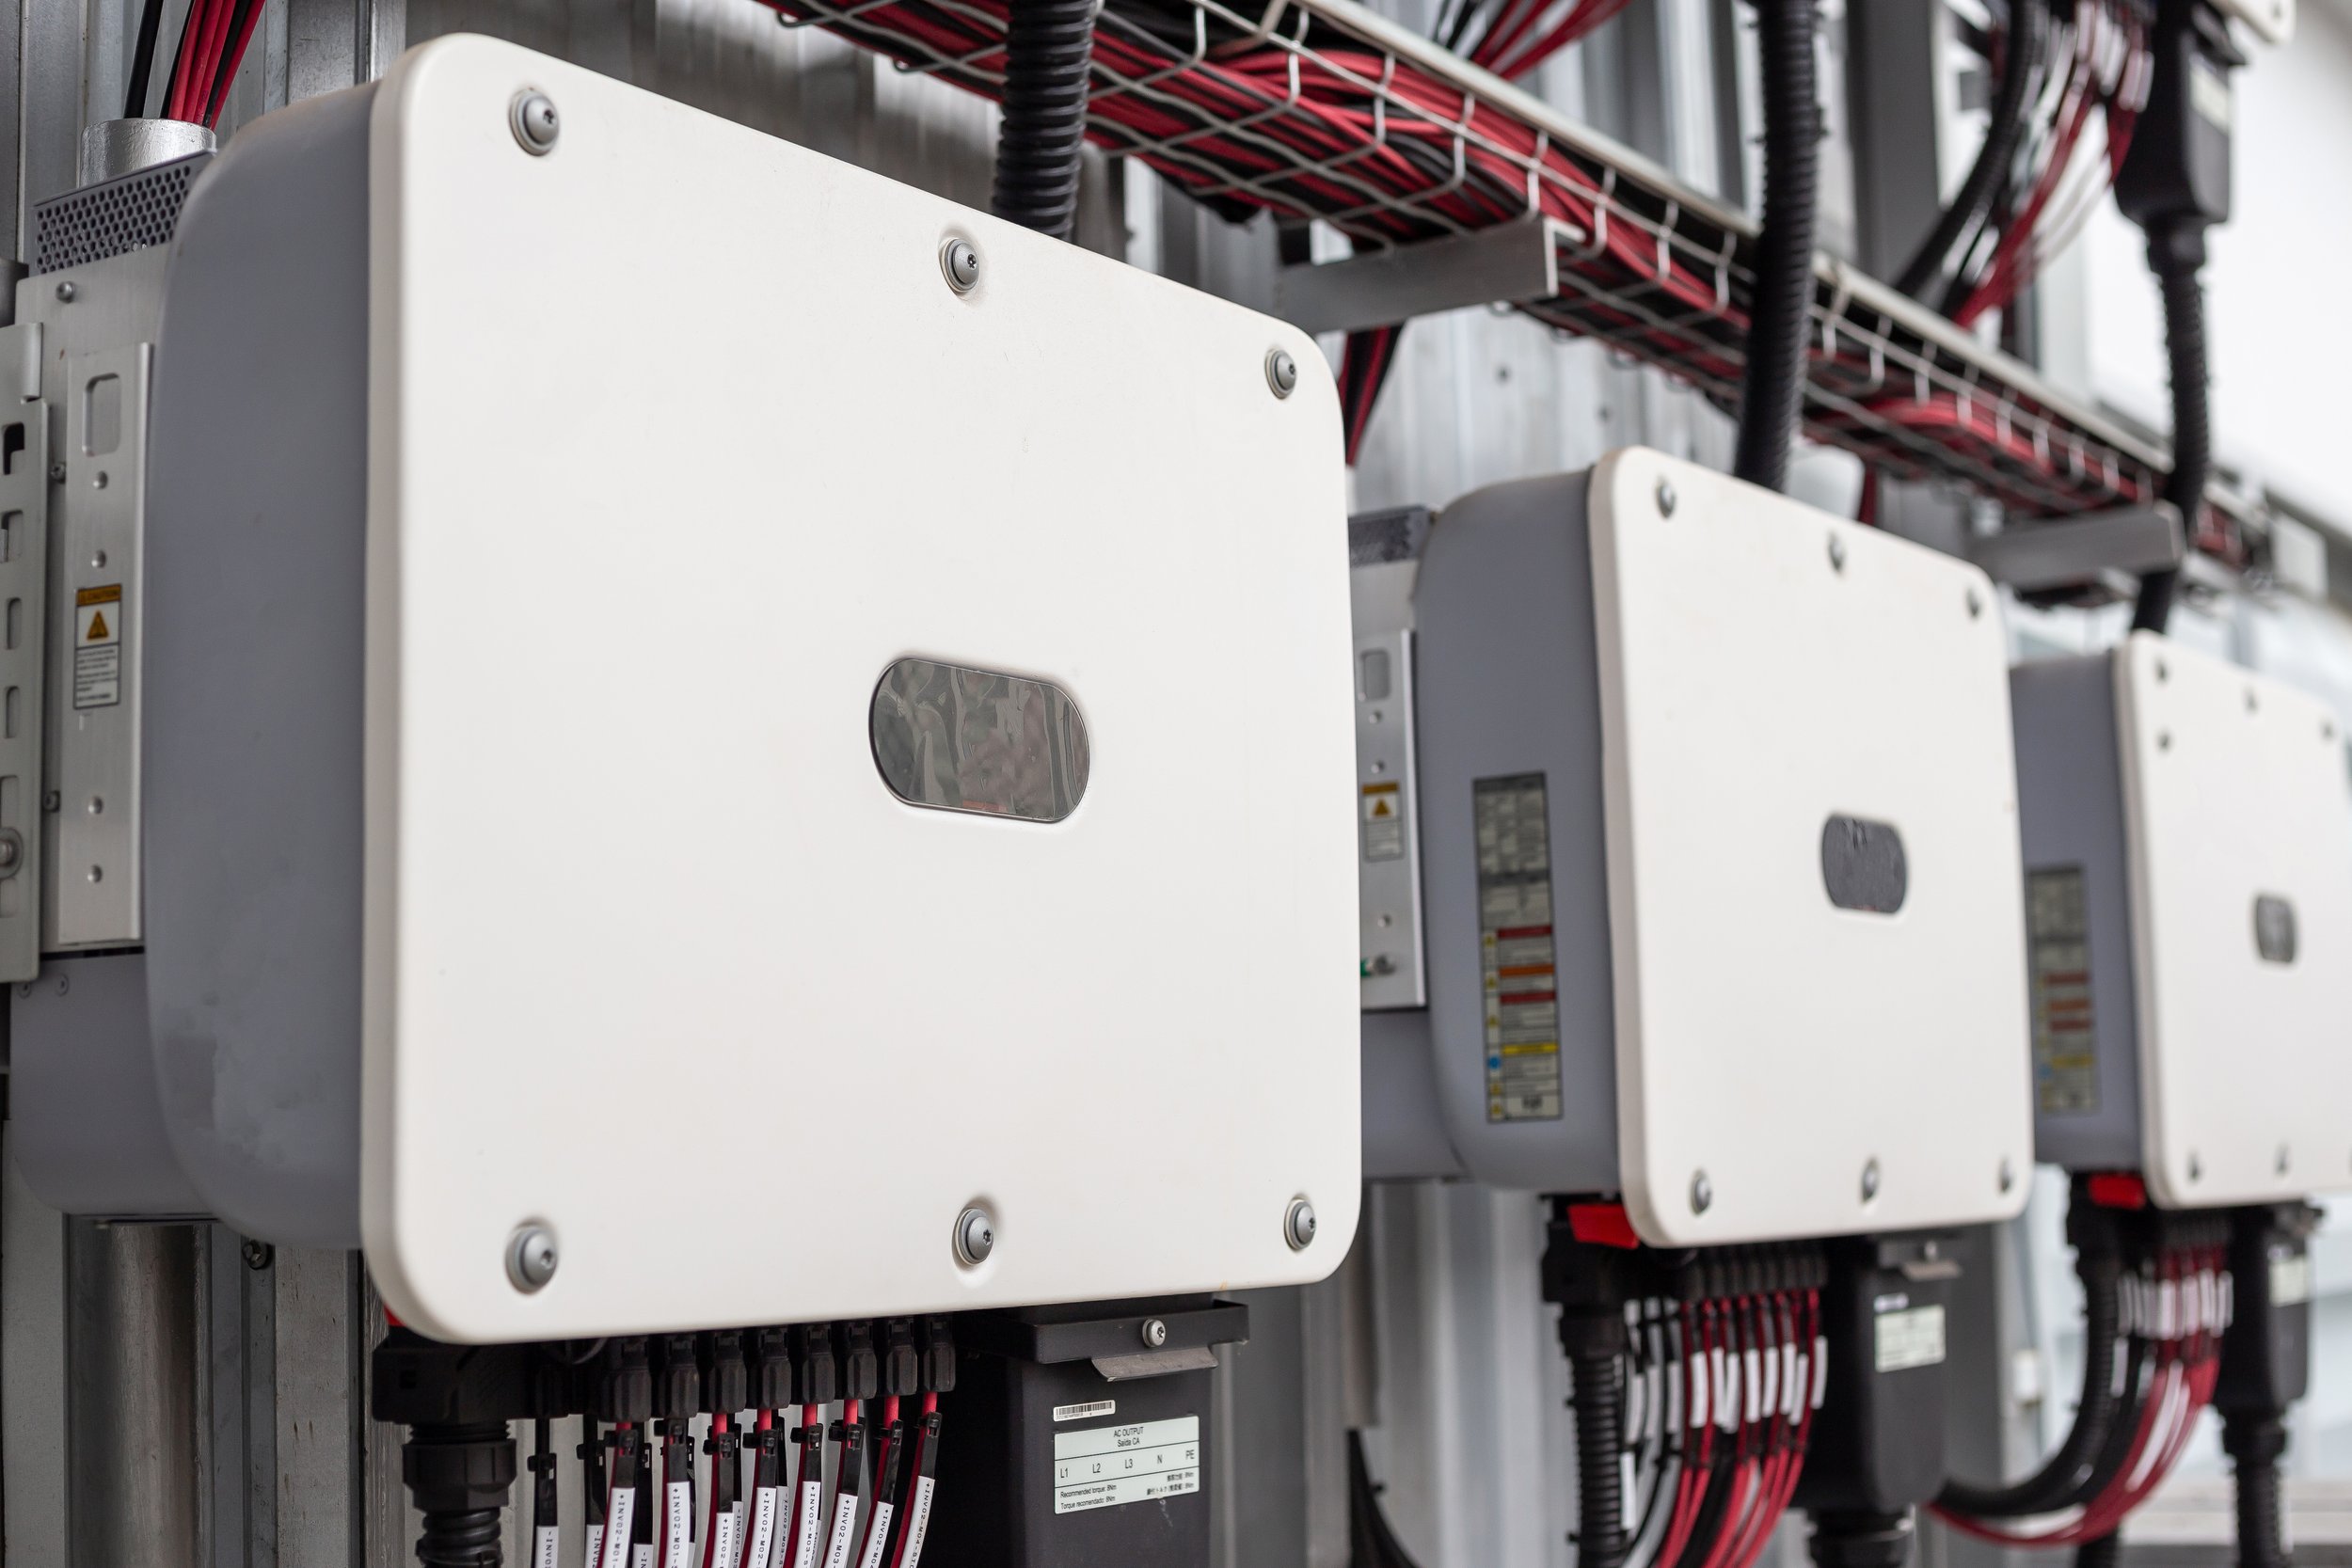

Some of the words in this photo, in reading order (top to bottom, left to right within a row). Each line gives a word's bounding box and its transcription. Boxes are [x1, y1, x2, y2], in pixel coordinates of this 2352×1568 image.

[1114, 1429, 1121, 1438] AC
[1122, 1427, 1144, 1437] OUTPUT
[1132, 1437, 1140, 1446] CA
[1060, 1467, 1069, 1479] L1
[1092, 1463, 1101, 1474] L2
[1125, 1459, 1133, 1469] L3
[1157, 1454, 1163, 1464] N
[1185, 1449, 1195, 1460] PE
[1060, 1488, 1091, 1498] Recommended
[544, 1531, 554, 1568] -INV0
